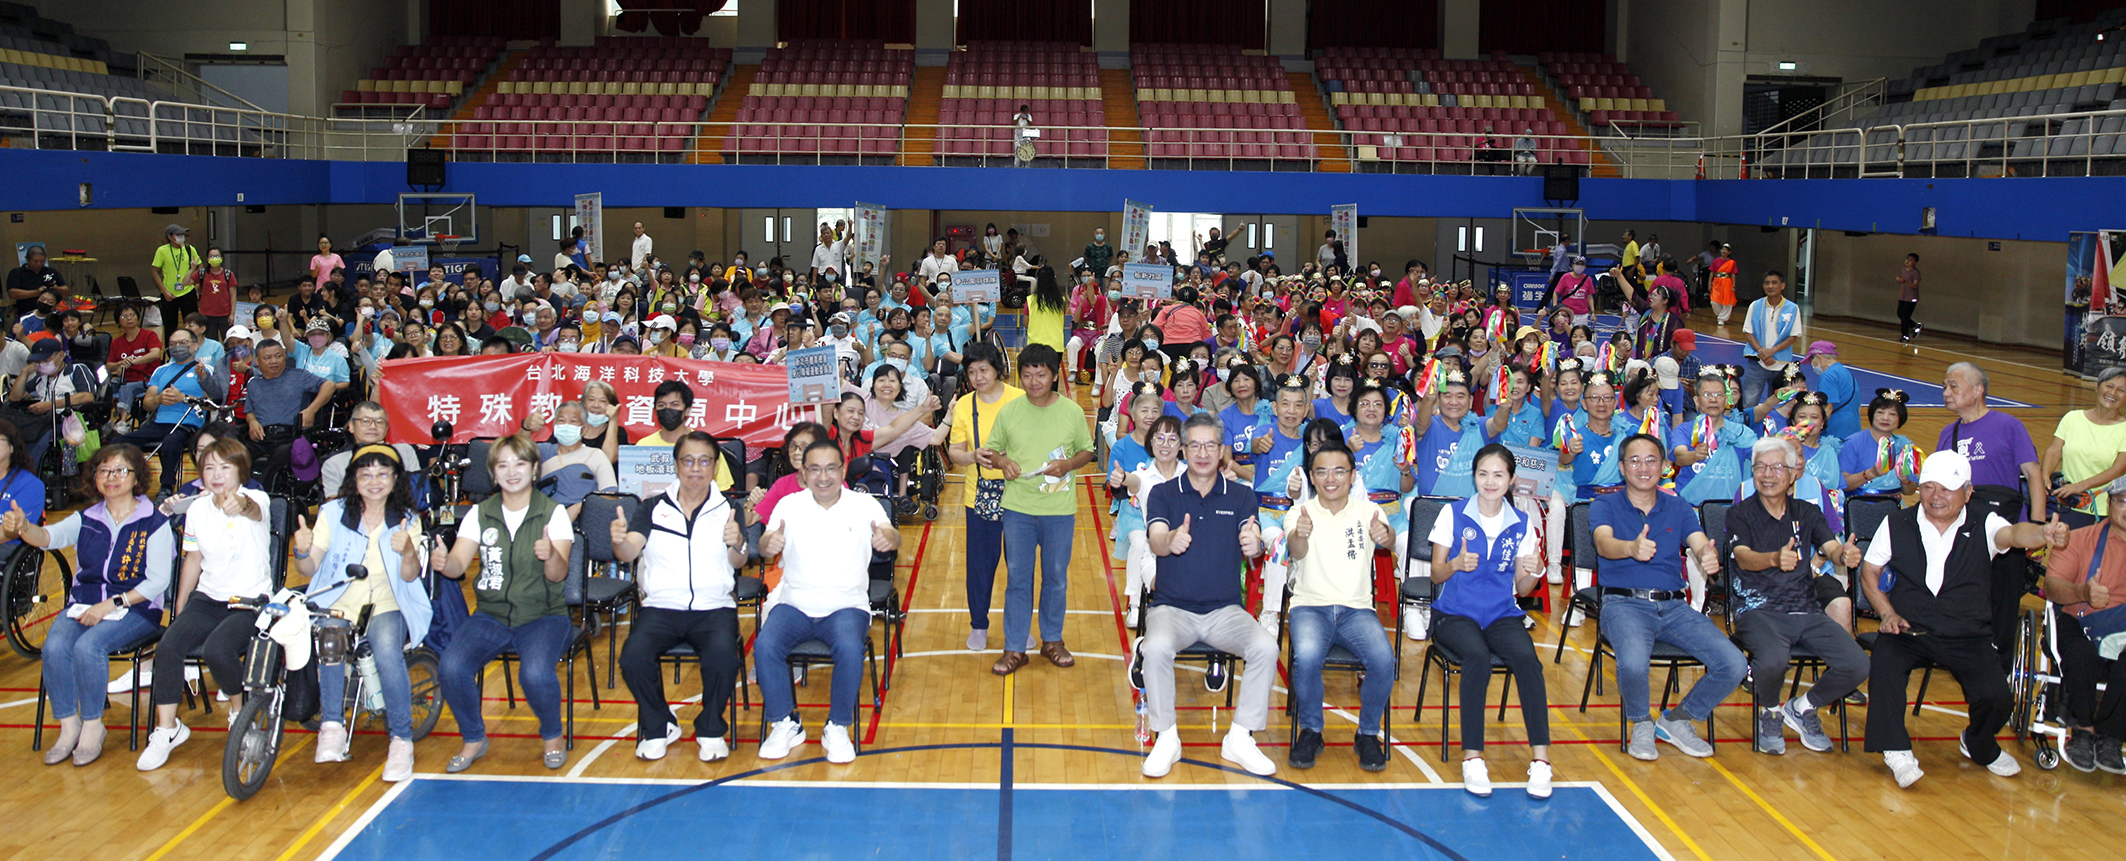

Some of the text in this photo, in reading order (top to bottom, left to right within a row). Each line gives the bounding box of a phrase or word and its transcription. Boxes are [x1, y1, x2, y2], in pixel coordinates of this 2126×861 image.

[526, 364, 715, 386] 台北海洋科技大學
[427, 392, 806, 431] 特殊教資源中心
[635, 463, 677, 475] 地板滾球
[1513, 455, 1546, 471] 中和慈光
[1357, 520, 1365, 550] 立法委員
[487, 546, 504, 590] 黃淑君
